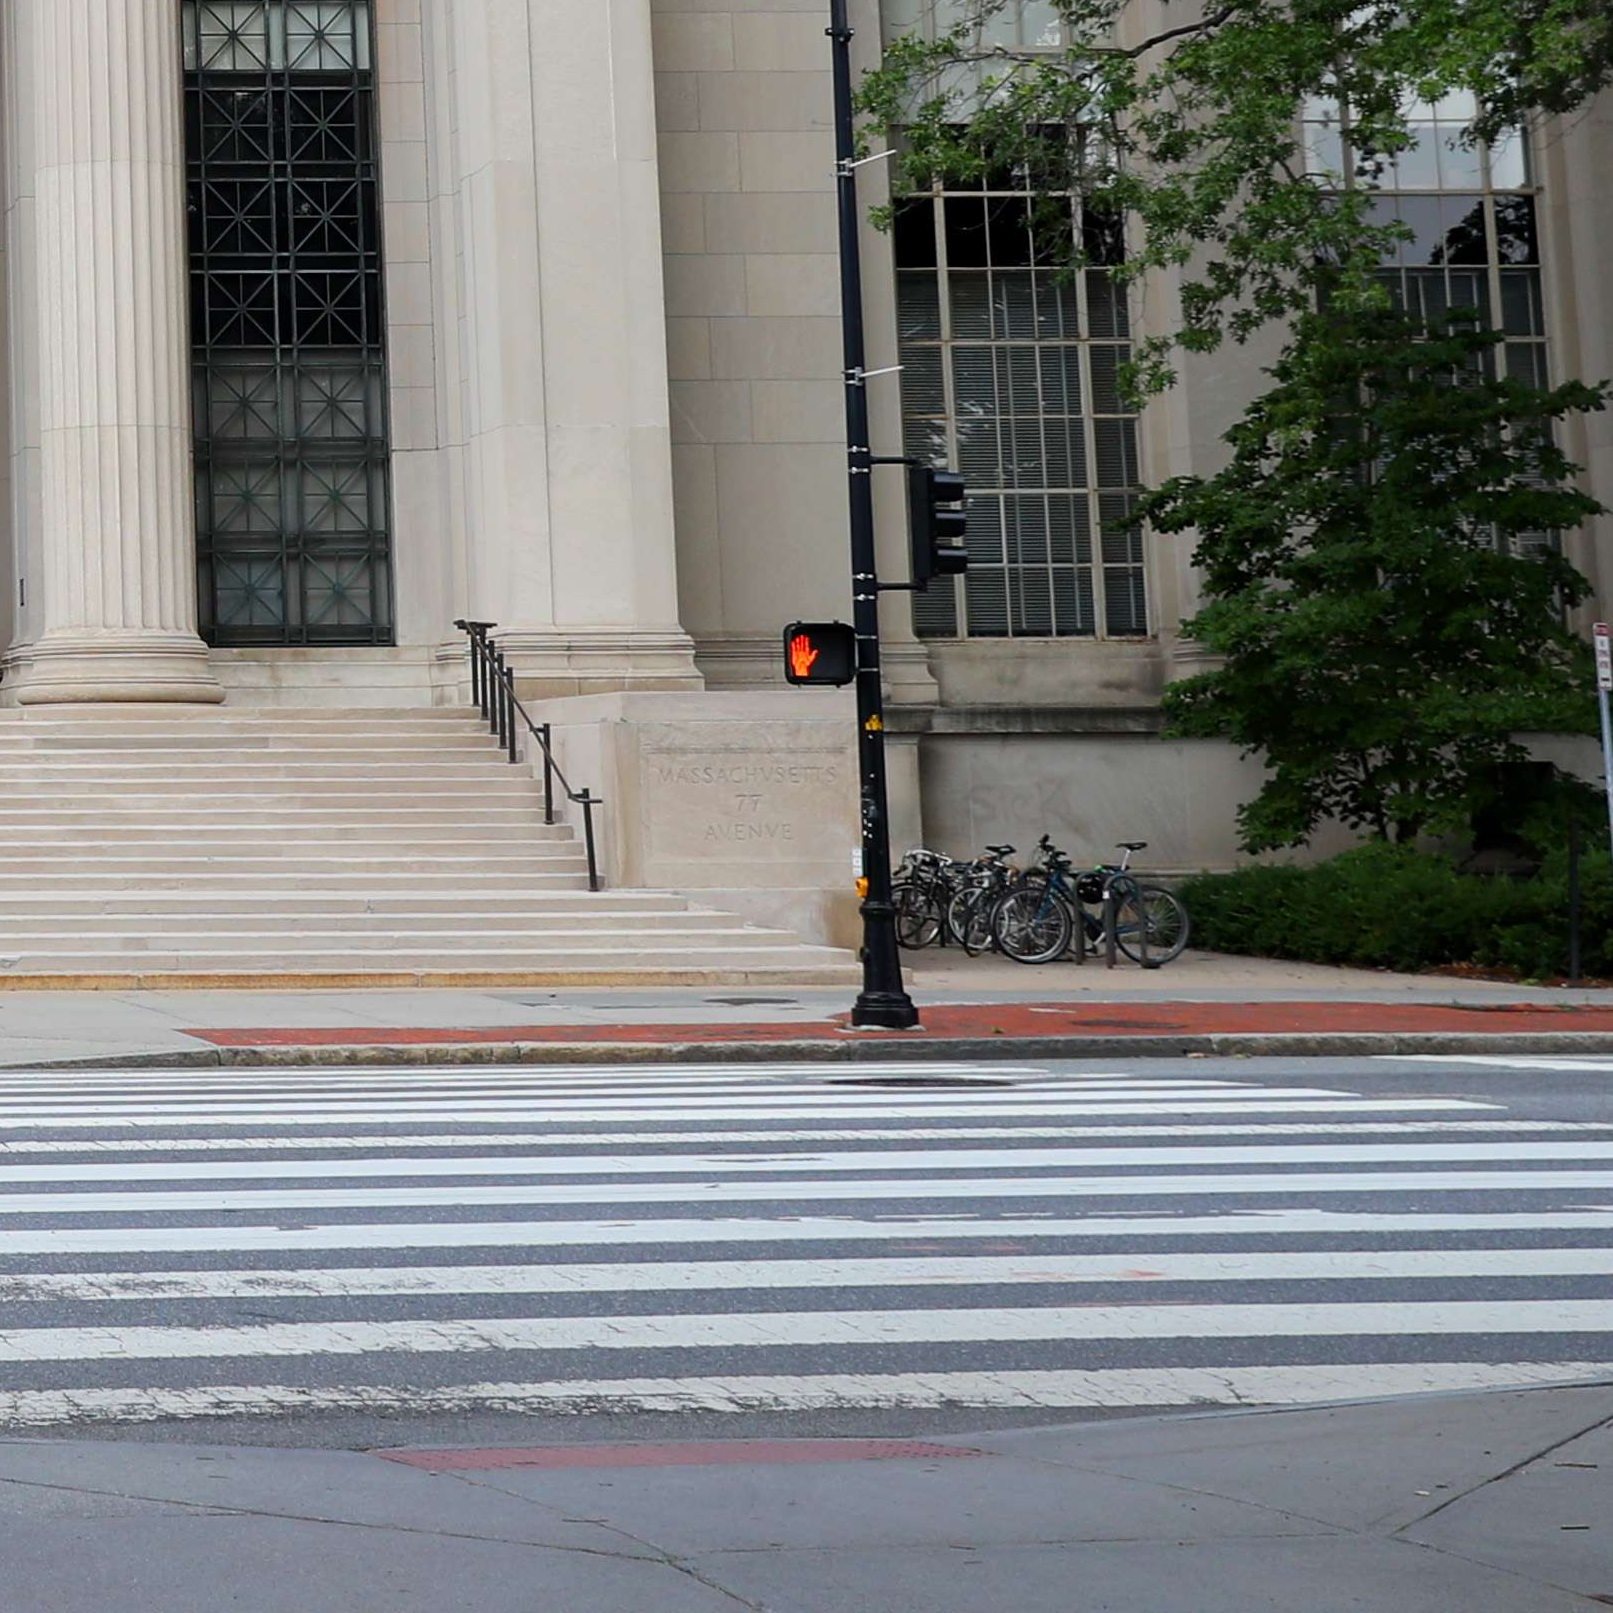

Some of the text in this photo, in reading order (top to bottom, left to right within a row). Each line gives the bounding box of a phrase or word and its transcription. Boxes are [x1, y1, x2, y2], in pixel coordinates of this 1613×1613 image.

[659, 766, 839, 783] MASSACHVSETTS
[735, 794, 763, 812] 77
[705, 824, 793, 840] AVENVE
